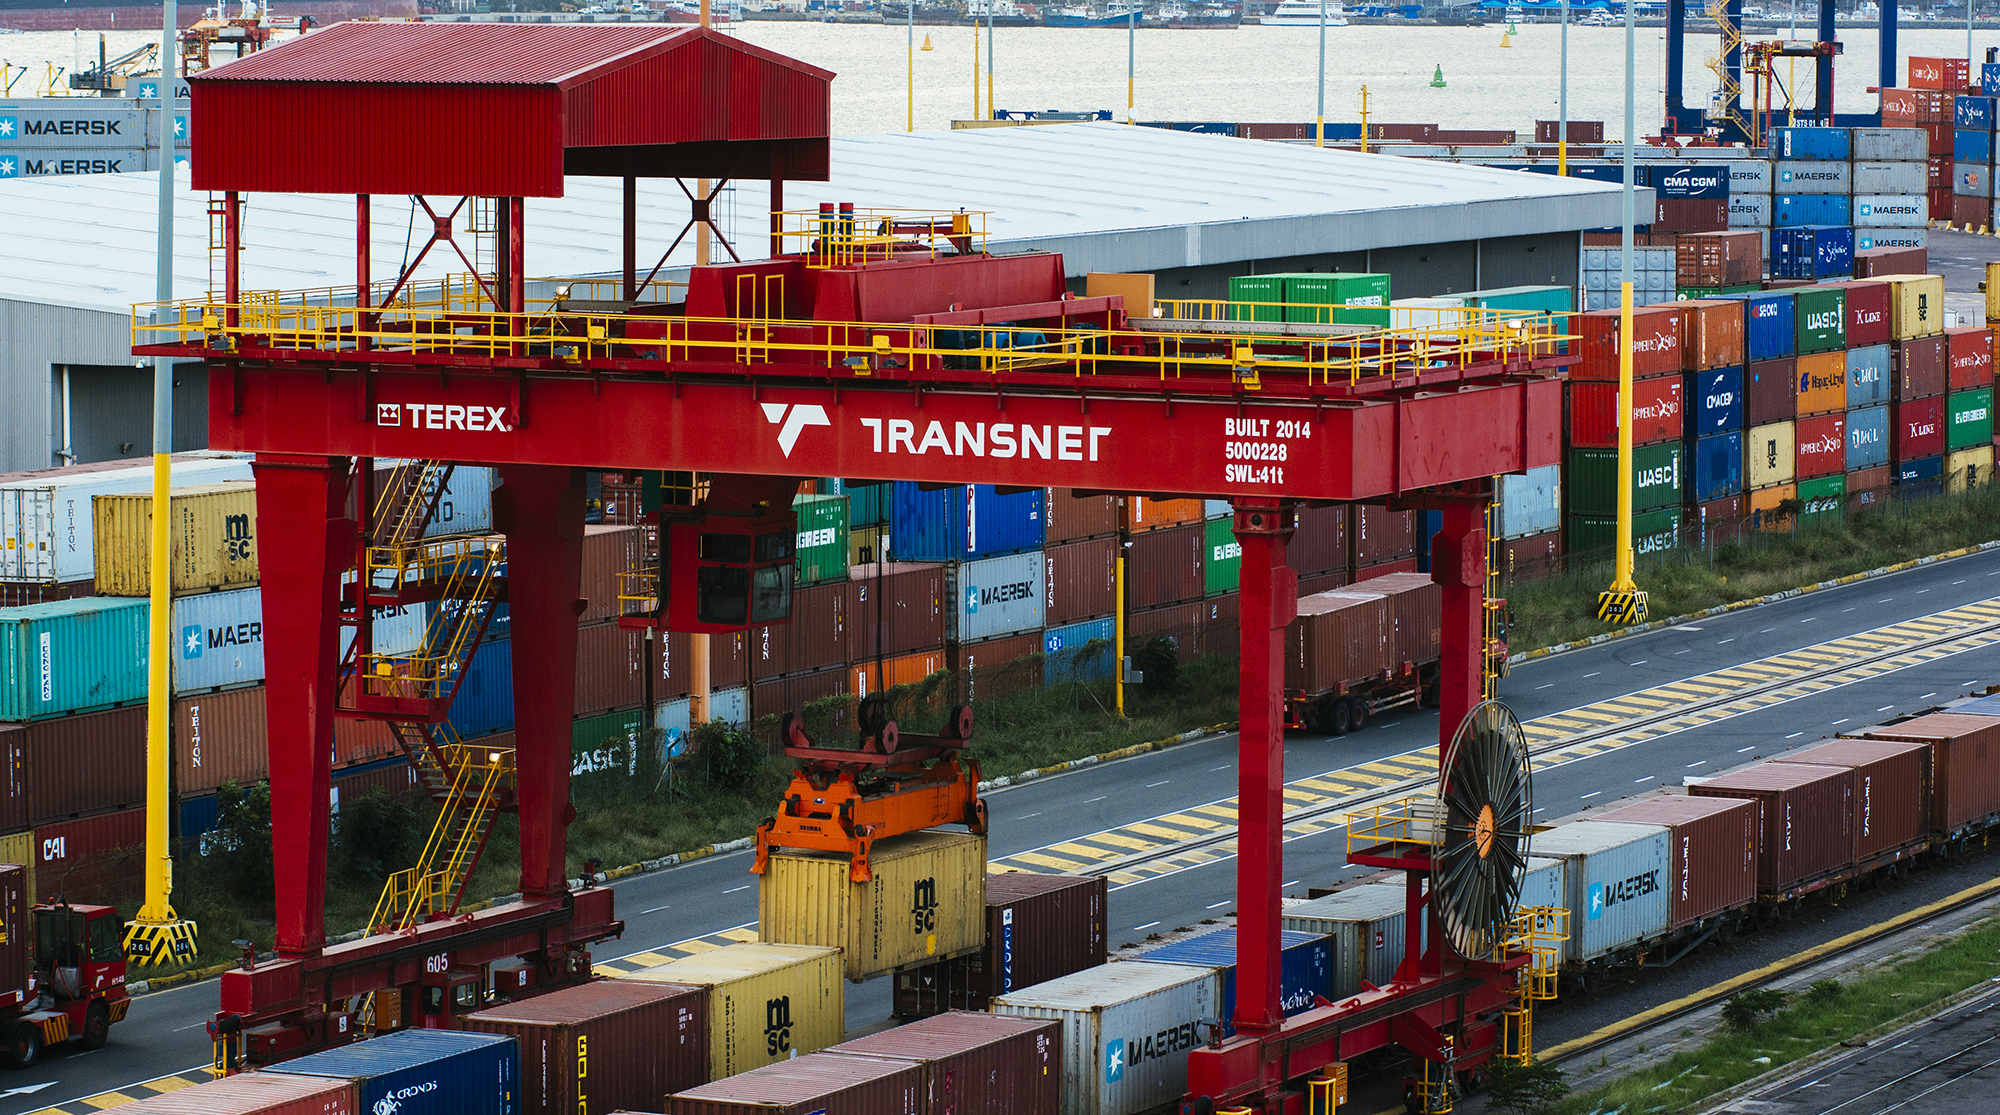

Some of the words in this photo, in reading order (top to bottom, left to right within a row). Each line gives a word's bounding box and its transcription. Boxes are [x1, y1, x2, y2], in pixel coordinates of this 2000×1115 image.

[25, 120, 121, 135] MAERSK
[1663, 177, 1689, 187] CMA
[1691, 177, 1717, 187] CGM
[1728, 172, 1761, 180] ERSK
[1728, 205, 1760, 214] ERSK
[1874, 206, 1918, 214] MAERSK
[1875, 239, 1919, 247] MAERSK
[1807, 311, 1837, 330] UASC
[859, 417, 1112, 461] TRANSNET
[1225, 418, 1269, 437] BUILT
[1276, 419, 1310, 439] 2014
[1225, 441, 1287, 462] 5000228
[1225, 464, 1283, 485] SWL:41t
[1638, 465, 1672, 488] UASC
[67, 499, 76, 552] TRITON
[797, 527, 835, 550] GREEN
[1213, 542, 1242, 561] EVERG
[981, 580, 1034, 606] MAERSK
[207, 621, 262, 649] MAER
[190, 706, 201, 768] TRITON
[800, 824, 822, 832] BROMMA
[43, 836, 66, 861] CAI
[1605, 868, 1660, 908] MAERSK
[132, 942, 150, 952] 264
[426, 952, 449, 974] 605
[1004, 926, 1012, 994] CRONO
[1128, 1020, 1202, 1067] MAERSK
[397, 1080, 438, 1101] CRONOS
